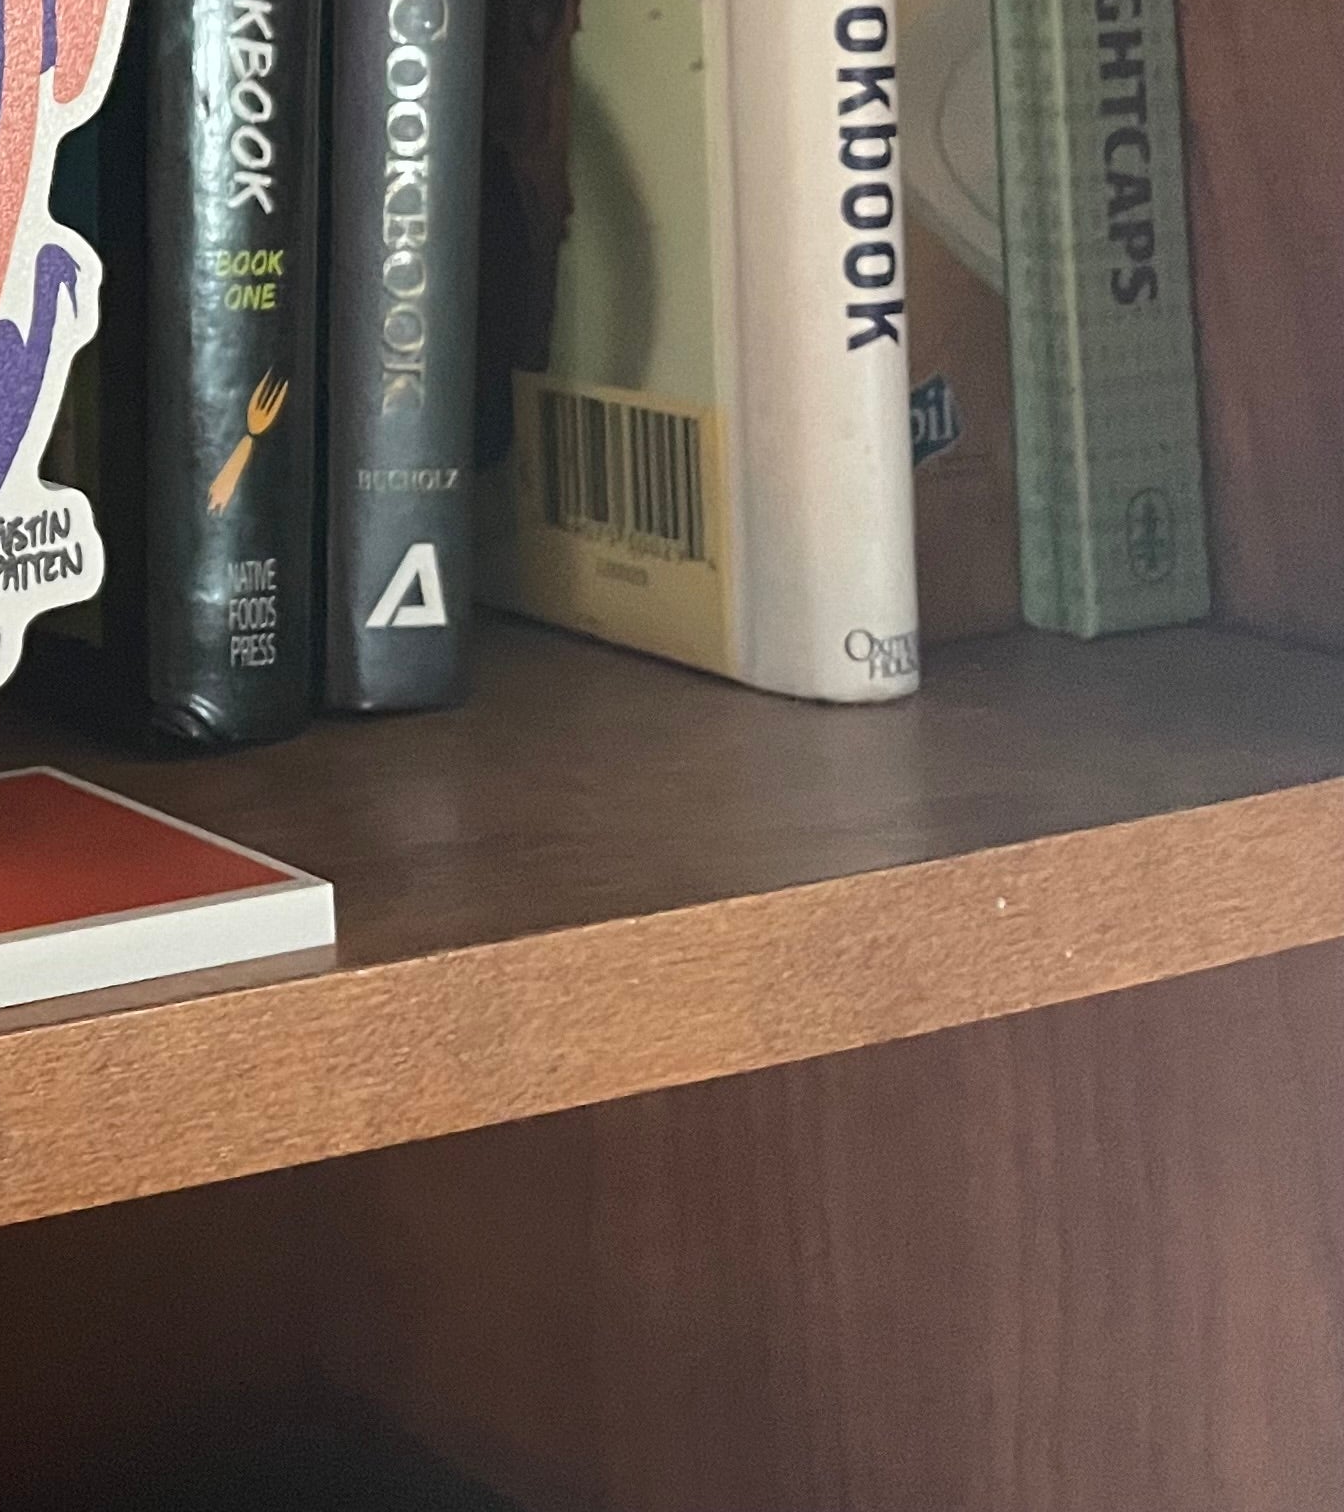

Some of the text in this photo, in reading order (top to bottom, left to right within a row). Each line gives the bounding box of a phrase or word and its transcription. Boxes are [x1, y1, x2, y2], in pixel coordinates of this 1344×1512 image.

[215, 248, 284, 277] BOOK
[223, 283, 276, 311] ONE
[227, 557, 278, 592] NATIVE
[228, 594, 278, 631] FOODS
[229, 633, 278, 668] PRESS
